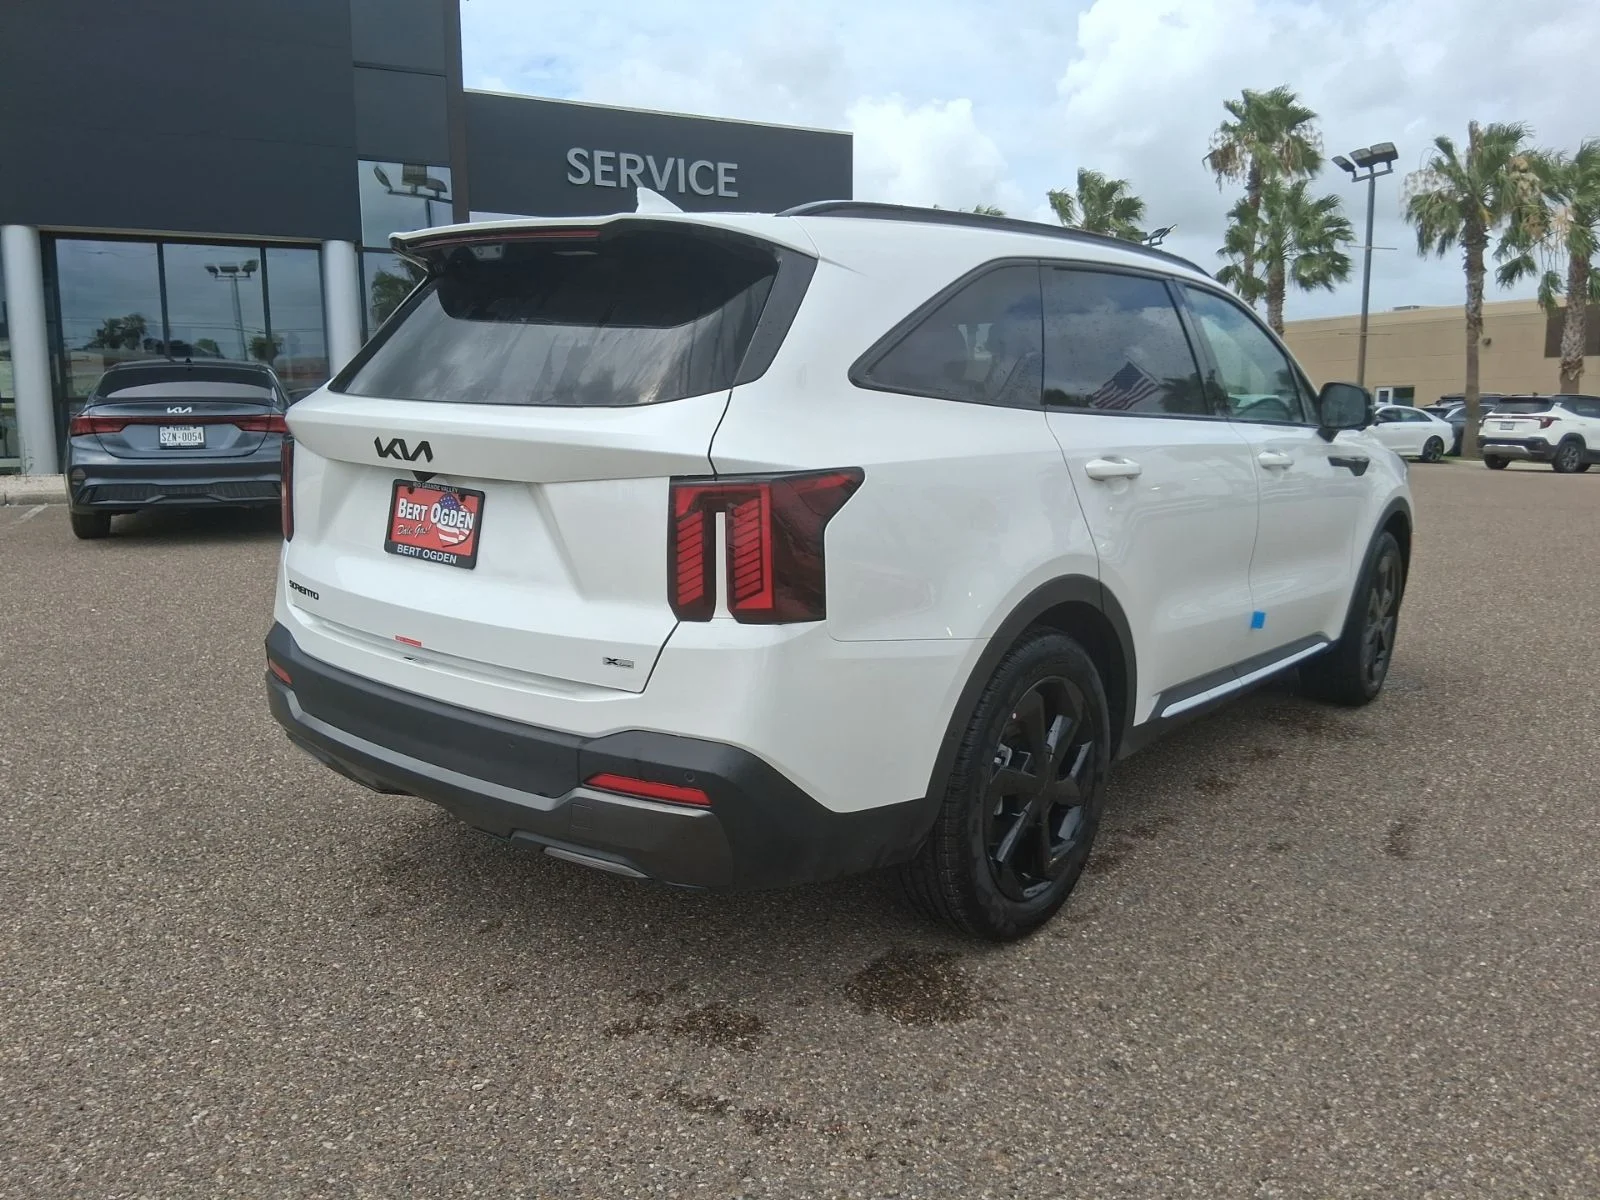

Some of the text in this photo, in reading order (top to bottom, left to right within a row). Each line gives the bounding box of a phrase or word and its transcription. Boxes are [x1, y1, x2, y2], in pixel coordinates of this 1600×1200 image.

[566, 147, 739, 198] SERVICE
[374, 436, 433, 463] KIA
[398, 498, 474, 529] BERT OGDEN
[397, 543, 457, 564] BERT OGDEN
